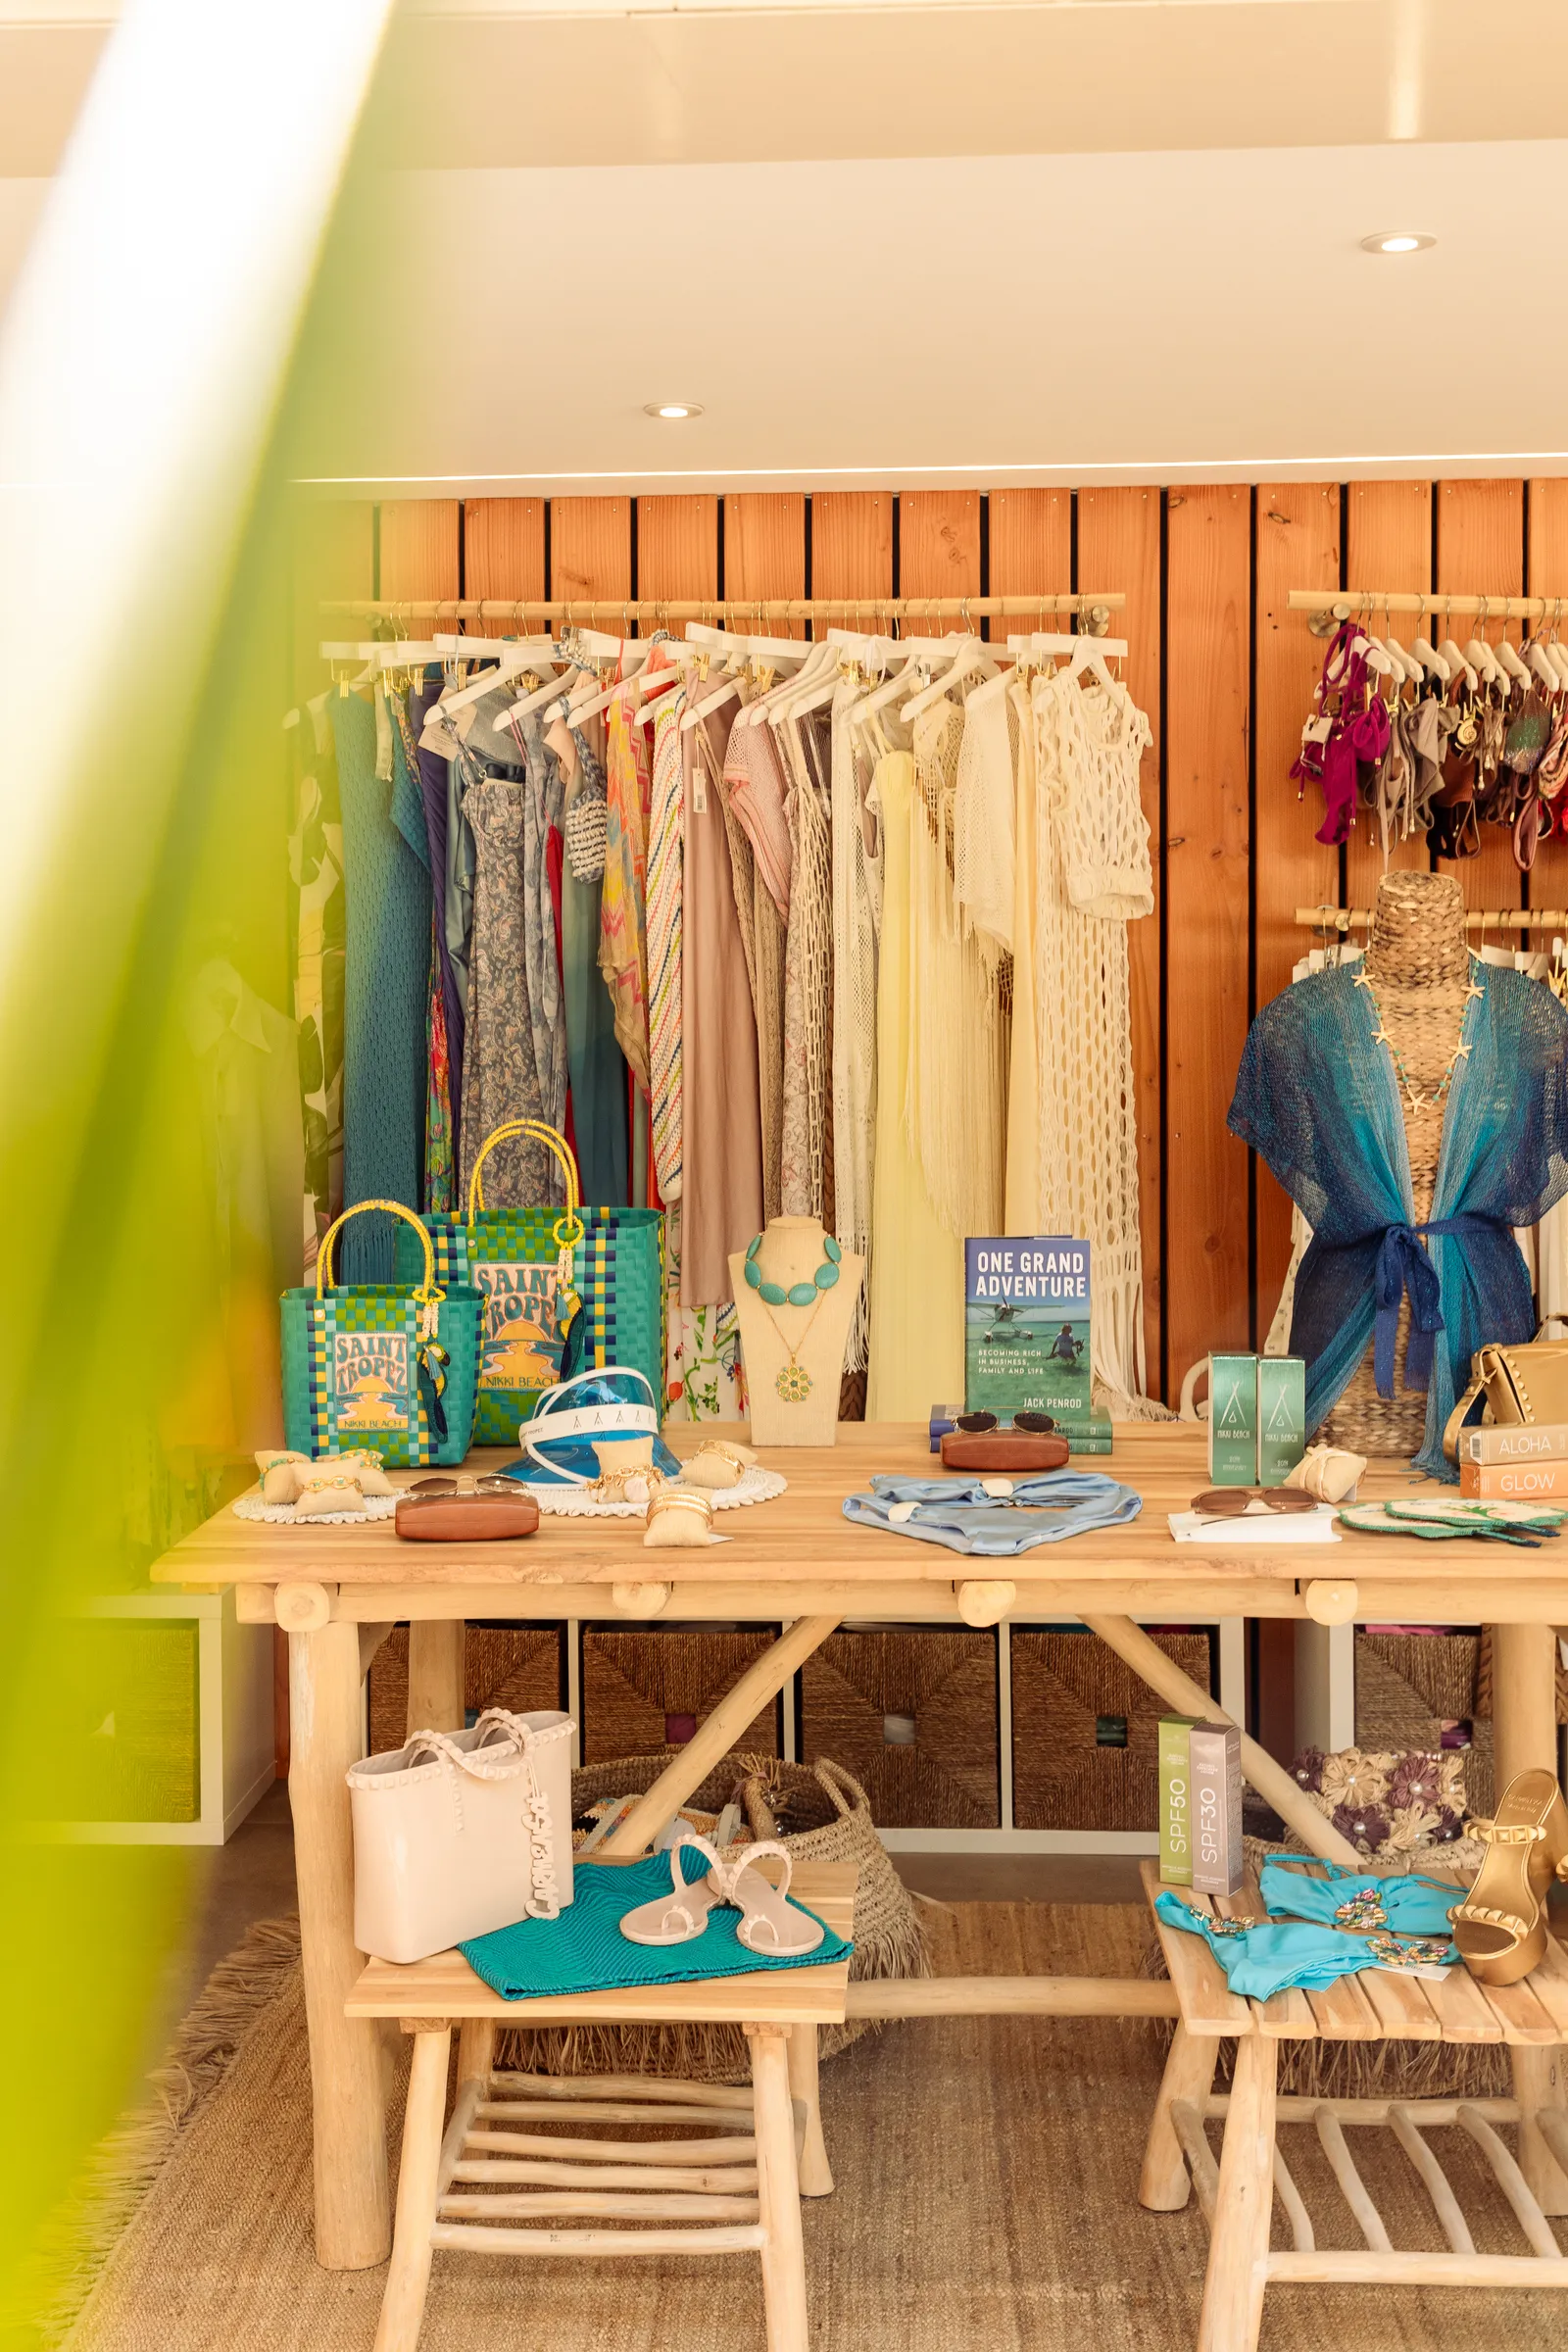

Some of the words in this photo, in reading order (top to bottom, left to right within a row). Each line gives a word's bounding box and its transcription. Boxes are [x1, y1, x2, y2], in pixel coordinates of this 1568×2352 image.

[978, 1251, 1013, 1273] ONE
[1020, 1251, 1084, 1274] GRAND
[975, 1276, 1086, 1298] ADVENTURE
[337, 1337, 406, 1363] SAINT
[337, 1356, 408, 1393] TROPEZ
[486, 1376, 514, 1387] NIKKI
[1023, 1397, 1045, 1408] JACK
[1047, 1397, 1082, 1409] PENROD
[344, 1420, 366, 1429] NIKKI
[369, 1419, 402, 1428] BEACH
[1232, 1430, 1250, 1440] BEACH
[1280, 1433, 1298, 1443] BEACH
[1498, 1436, 1552, 1455] ALOHA
[1500, 1472, 1555, 1492] GLOW
[1169, 1778, 1187, 1854] SPF50
[1200, 1787, 1218, 1864] SPF30
